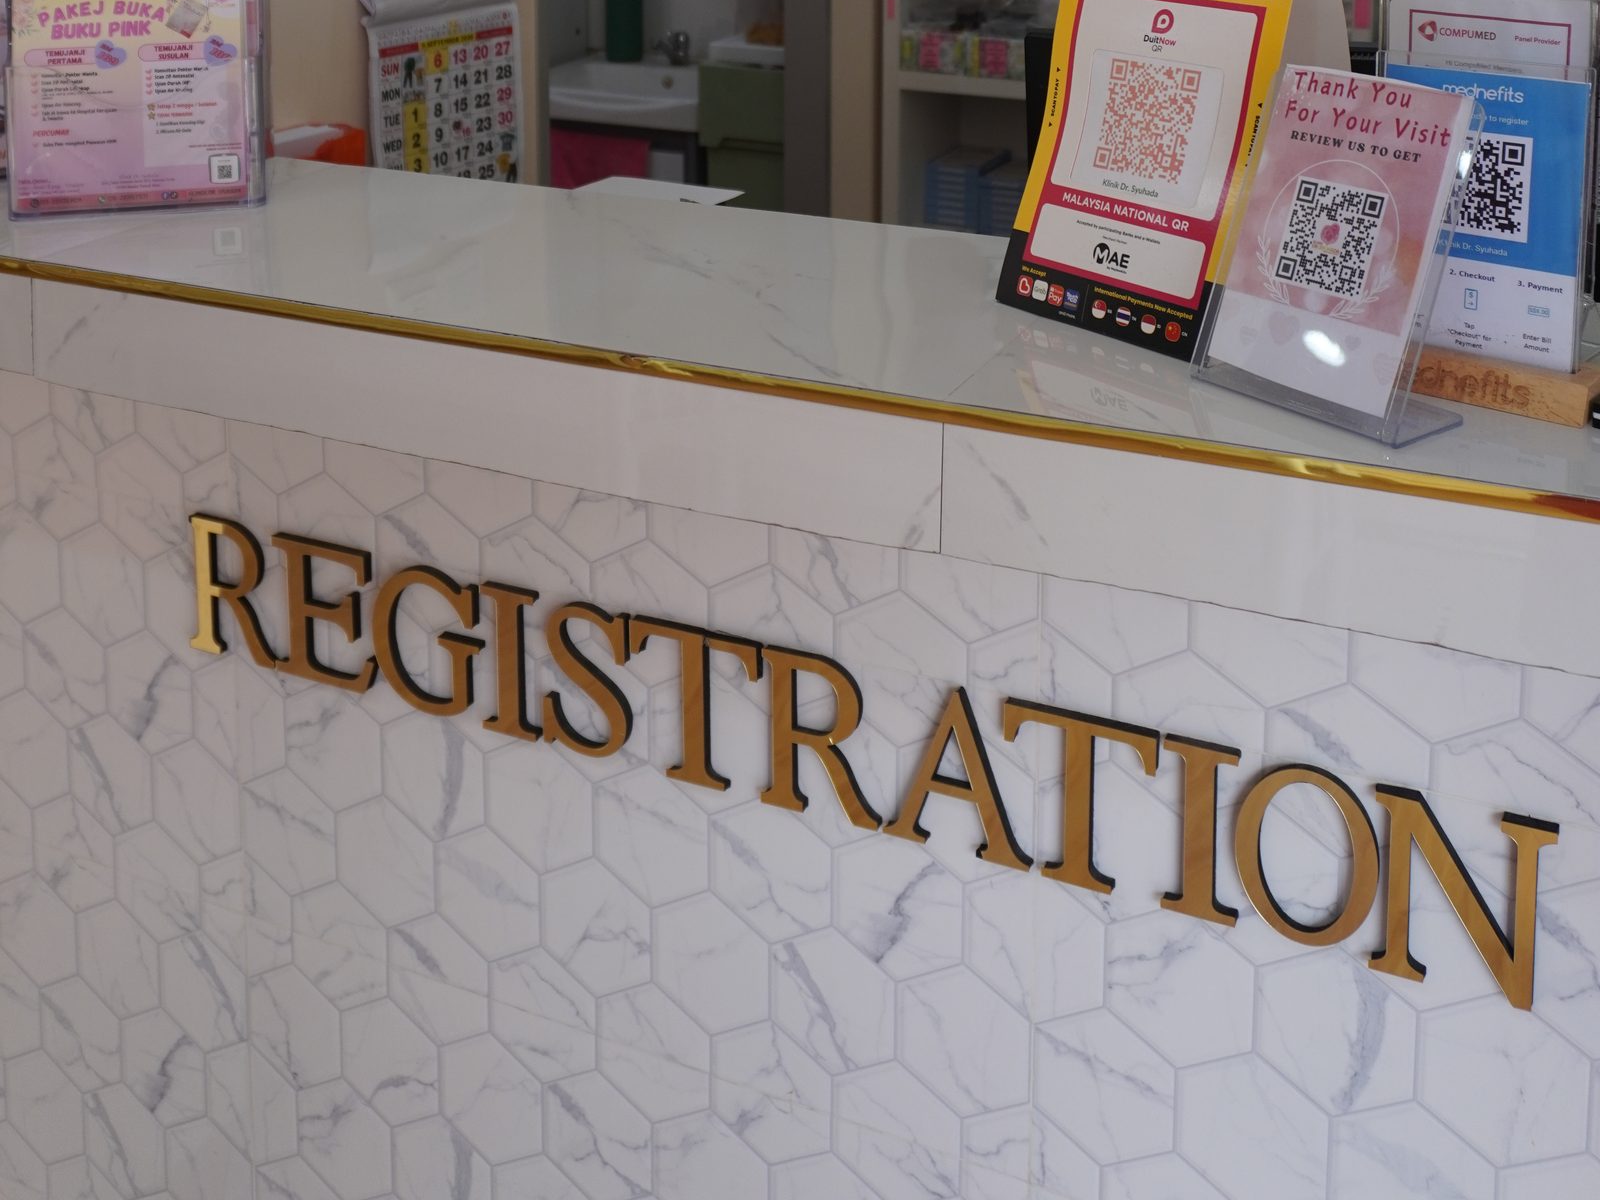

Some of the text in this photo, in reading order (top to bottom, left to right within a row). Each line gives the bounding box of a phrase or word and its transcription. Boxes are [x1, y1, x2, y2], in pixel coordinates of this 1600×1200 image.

[37, 0, 165, 27] PAKEJ BUKA
[51, 20, 151, 40] BUKU PINK
[1439, 27, 1497, 41] COMPUMED
[1143, 35, 1177, 47] DuitNow
[1152, 44, 1163, 52] QR
[1515, 35, 1561, 46] Panel Provider
[158, 52, 189, 60] SUSULAN
[381, 41, 511, 77] SUN 6 13 20 27
[381, 64, 512, 102] MON 7 14 21 28
[1295, 71, 1412, 109] Thank You
[1442, 82, 1524, 104] mednefits
[384, 87, 512, 127] TUE 1 8 15 22 29
[1284, 100, 1451, 147] For Your Visit
[1498, 116, 1529, 126] register
[383, 139, 402, 154] WED
[412, 133, 421, 148] 2
[435, 127, 444, 143] 9
[475, 116, 492, 132] 23
[497, 110, 513, 125] 30
[1290, 130, 1421, 163] REVIEW US TO GET
[413, 158, 422, 172] 3
[433, 151, 448, 168] 10
[455, 146, 470, 162] 17
[477, 140, 493, 157] 24
[478, 164, 495, 179] 25
[1102, 178, 1159, 198] Klinik Dr. Syuhada
[1062, 192, 1189, 232] MALAYSIA NATIONAL QR
[1093, 242, 1131, 269] MAE
[1462, 242, 1474, 251] Dr.
[1475, 245, 1508, 257] Syuhada
[1030, 267, 1047, 277] Accept
[1449, 268, 1495, 283] 2. Checkout
[1527, 281, 1563, 294] Payment
[1048, 292, 1062, 305] Pay
[1094, 286, 1193, 320] International Payments Now Accepted
[1464, 321, 1475, 330] Tap
[1455, 339, 1482, 350] Payment
[1522, 333, 1552, 344] Enter Bill
[1523, 343, 1550, 353] Amount
[188, 513, 1560, 1012] REGISTRATION
